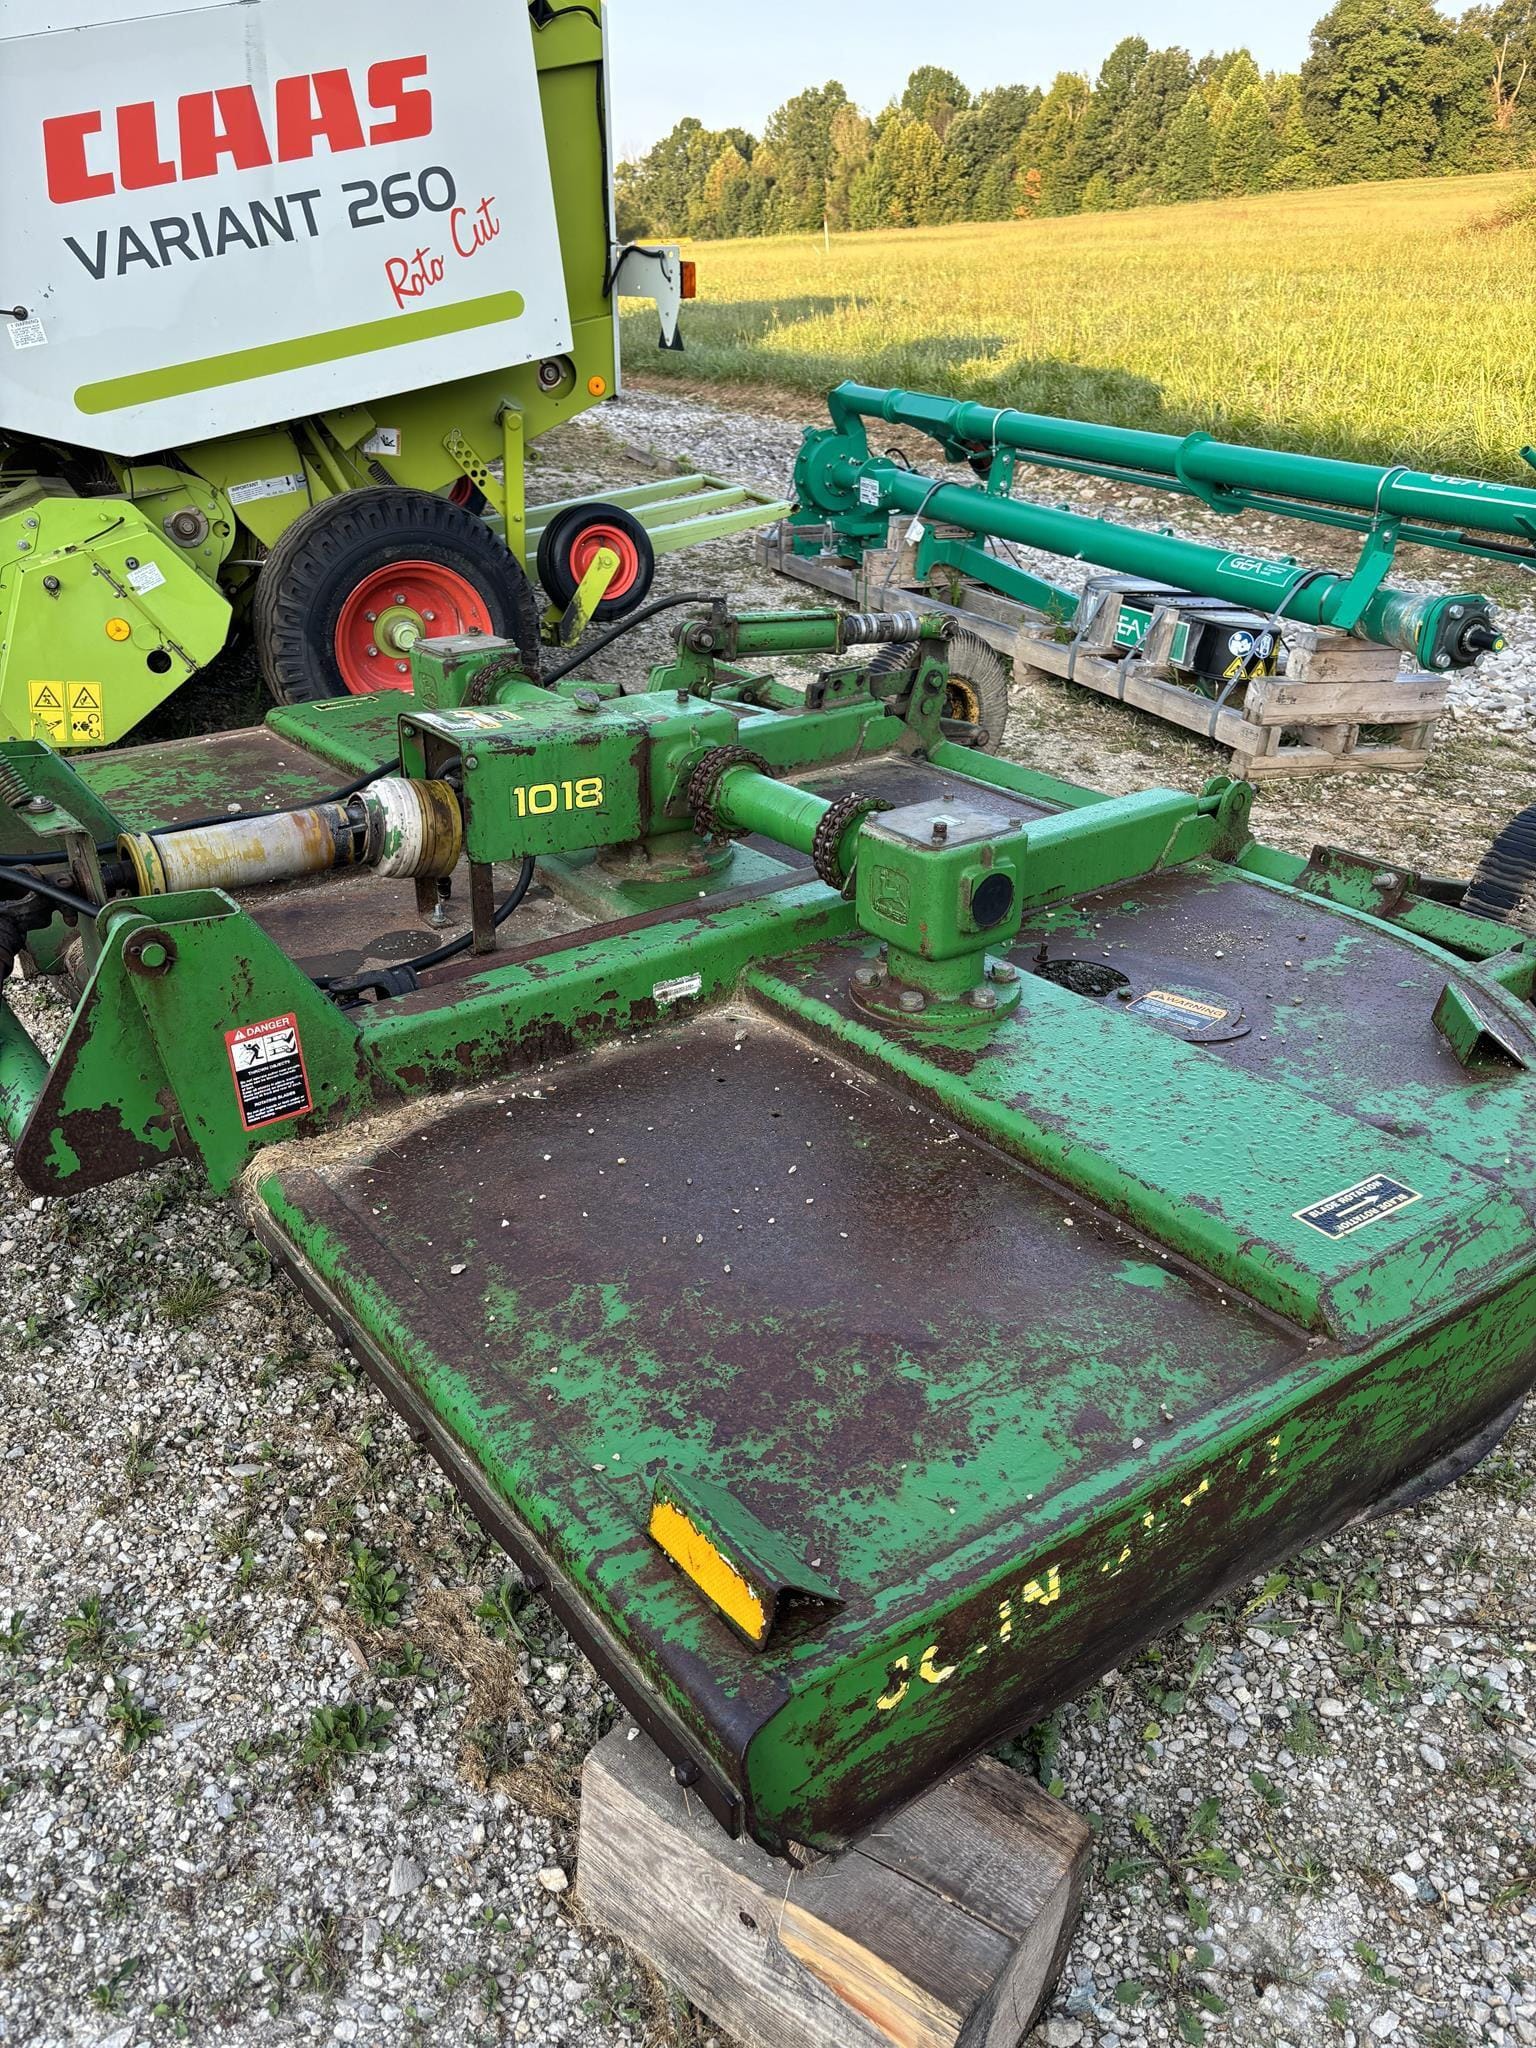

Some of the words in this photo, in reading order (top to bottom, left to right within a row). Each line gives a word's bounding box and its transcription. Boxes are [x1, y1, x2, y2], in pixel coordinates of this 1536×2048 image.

[43, 56, 433, 205] CLAAS
[63, 188, 321, 281] VARIANT
[341, 166, 457, 229] 260
[385, 247, 444, 309] Roto
[451, 197, 500, 258] Cut
[1230, 557, 1263, 574] GEA
[1117, 615, 1140, 639] EA
[513, 777, 603, 817] 1018
[1166, 997, 1223, 1017] WARNING
[246, 1017, 290, 1037] DANGER
[1307, 1200, 1340, 1218] BLADE
[1338, 1180, 1383, 1205] ROTATION
[1380, 1193, 1409, 1211] BLADE
